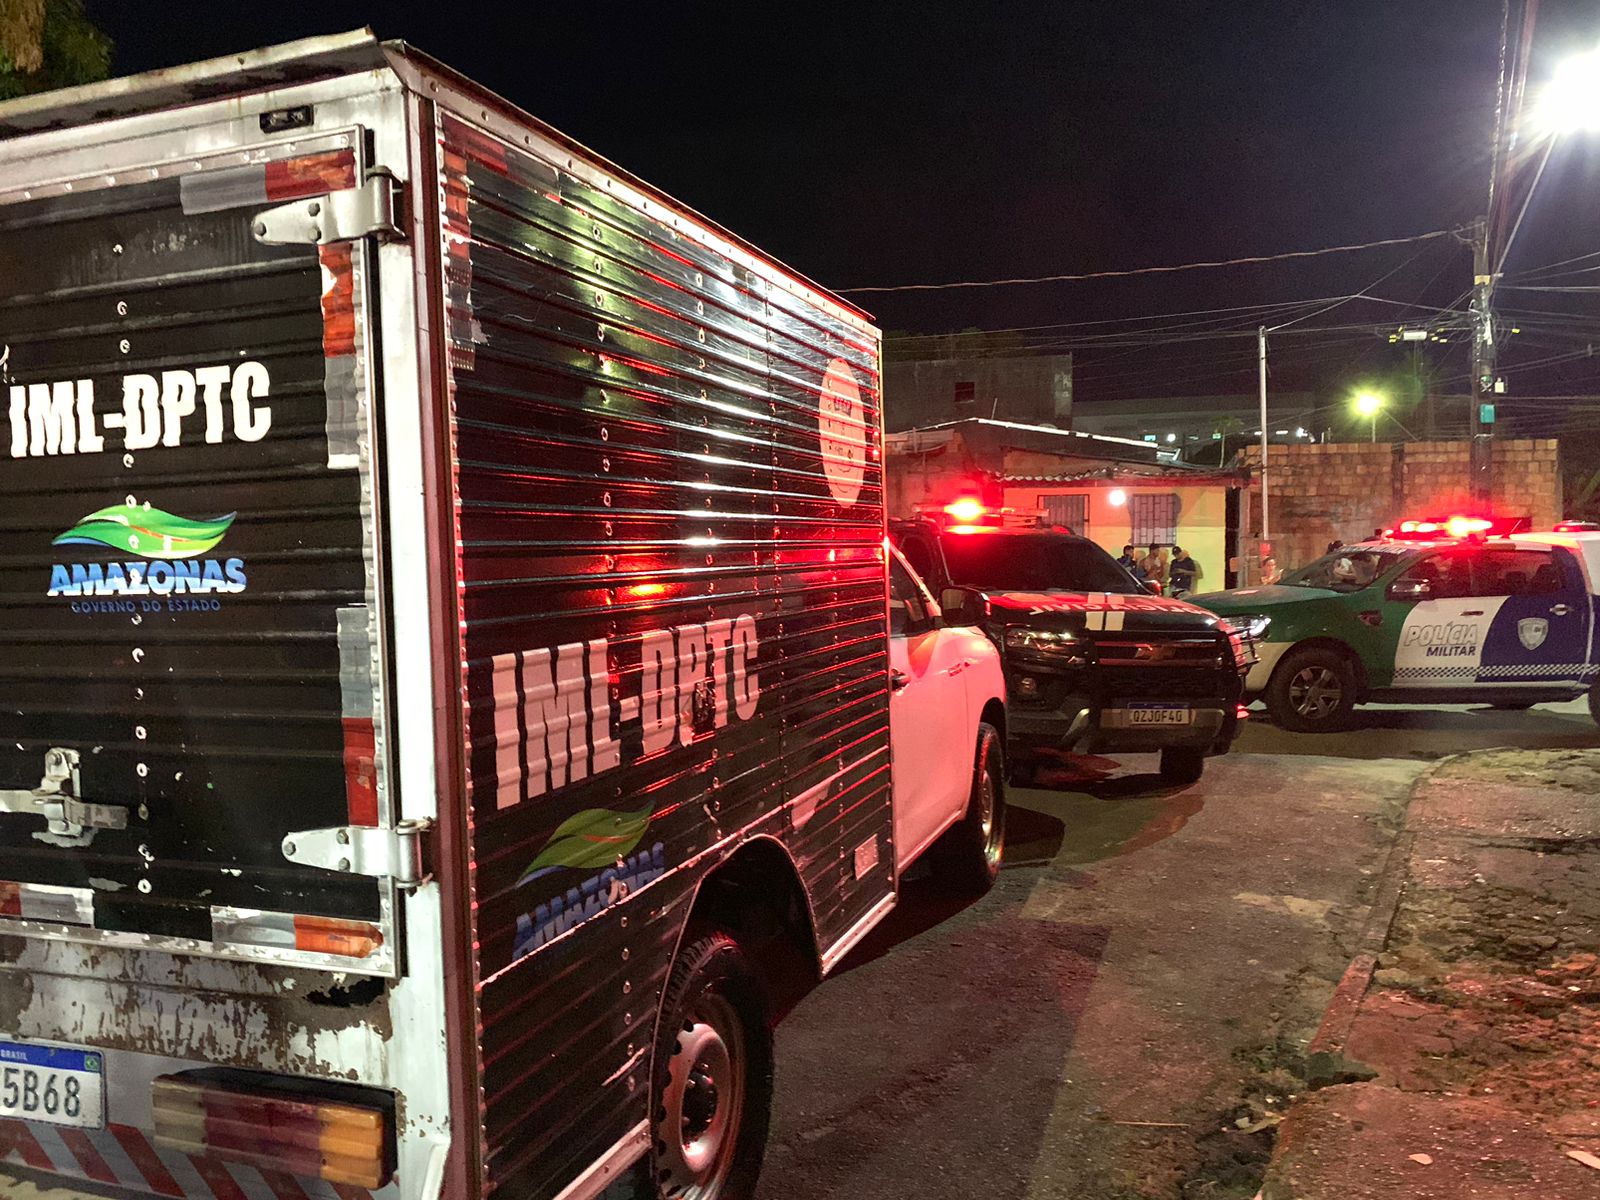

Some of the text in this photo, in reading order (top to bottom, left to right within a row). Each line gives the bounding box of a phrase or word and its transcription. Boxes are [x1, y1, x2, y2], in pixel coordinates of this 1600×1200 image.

[8, 361, 272, 457] IML-DPTC
[47, 558, 247, 596] AMAZONAS
[72, 600, 222, 613] GOVERNO DO ESTADO
[1404, 621, 1477, 646] POLÍCIA
[1426, 646, 1476, 656] MILITAR
[492, 613, 759, 810] IML-DPTC
[1, 1049, 27, 1060] BRASIL
[3, 1067, 80, 1117] 5B68
